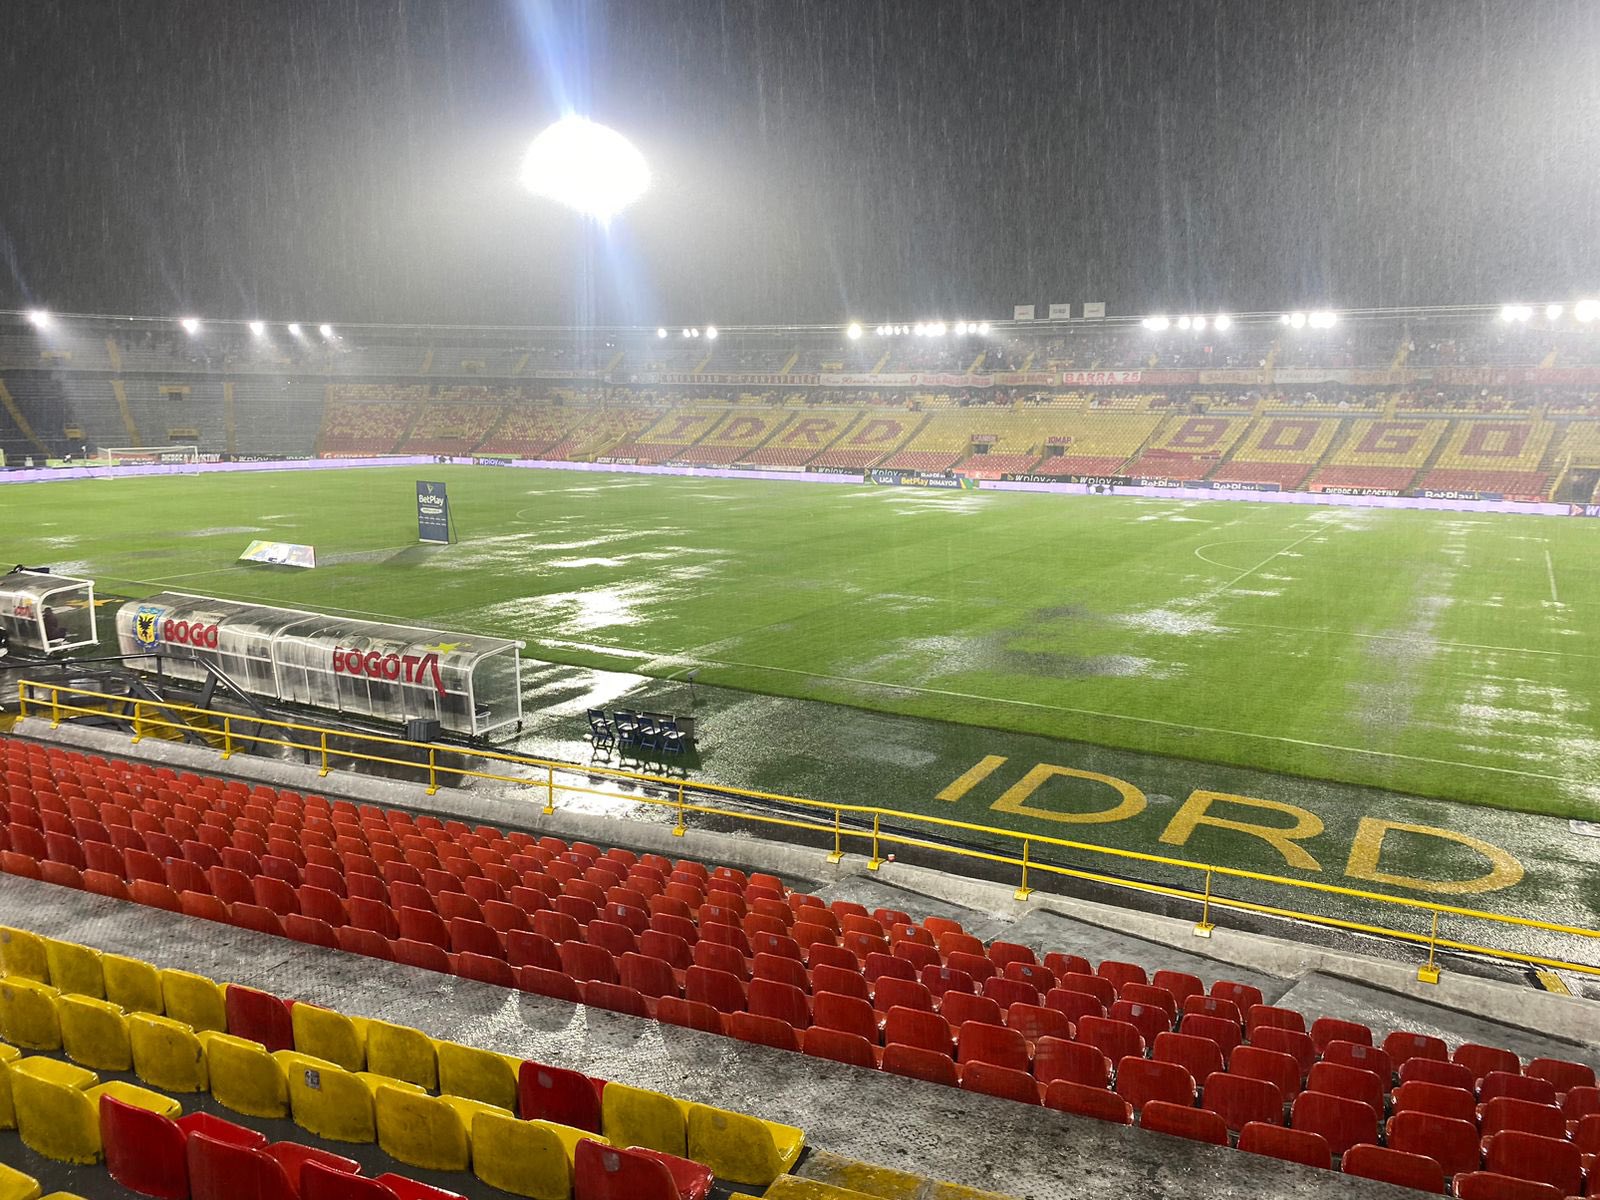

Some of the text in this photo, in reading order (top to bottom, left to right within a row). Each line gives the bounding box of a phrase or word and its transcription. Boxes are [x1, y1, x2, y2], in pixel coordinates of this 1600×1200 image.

[1065, 373, 1116, 384] BARRA
[655, 415, 904, 445] IDRD
[1167, 418, 1530, 457] BOGO
[900, 477, 928, 486] BetPlay
[418, 495, 444, 506] BetPlay
[164, 619, 219, 649] BOGO
[935, 755, 1524, 895] IDRD
